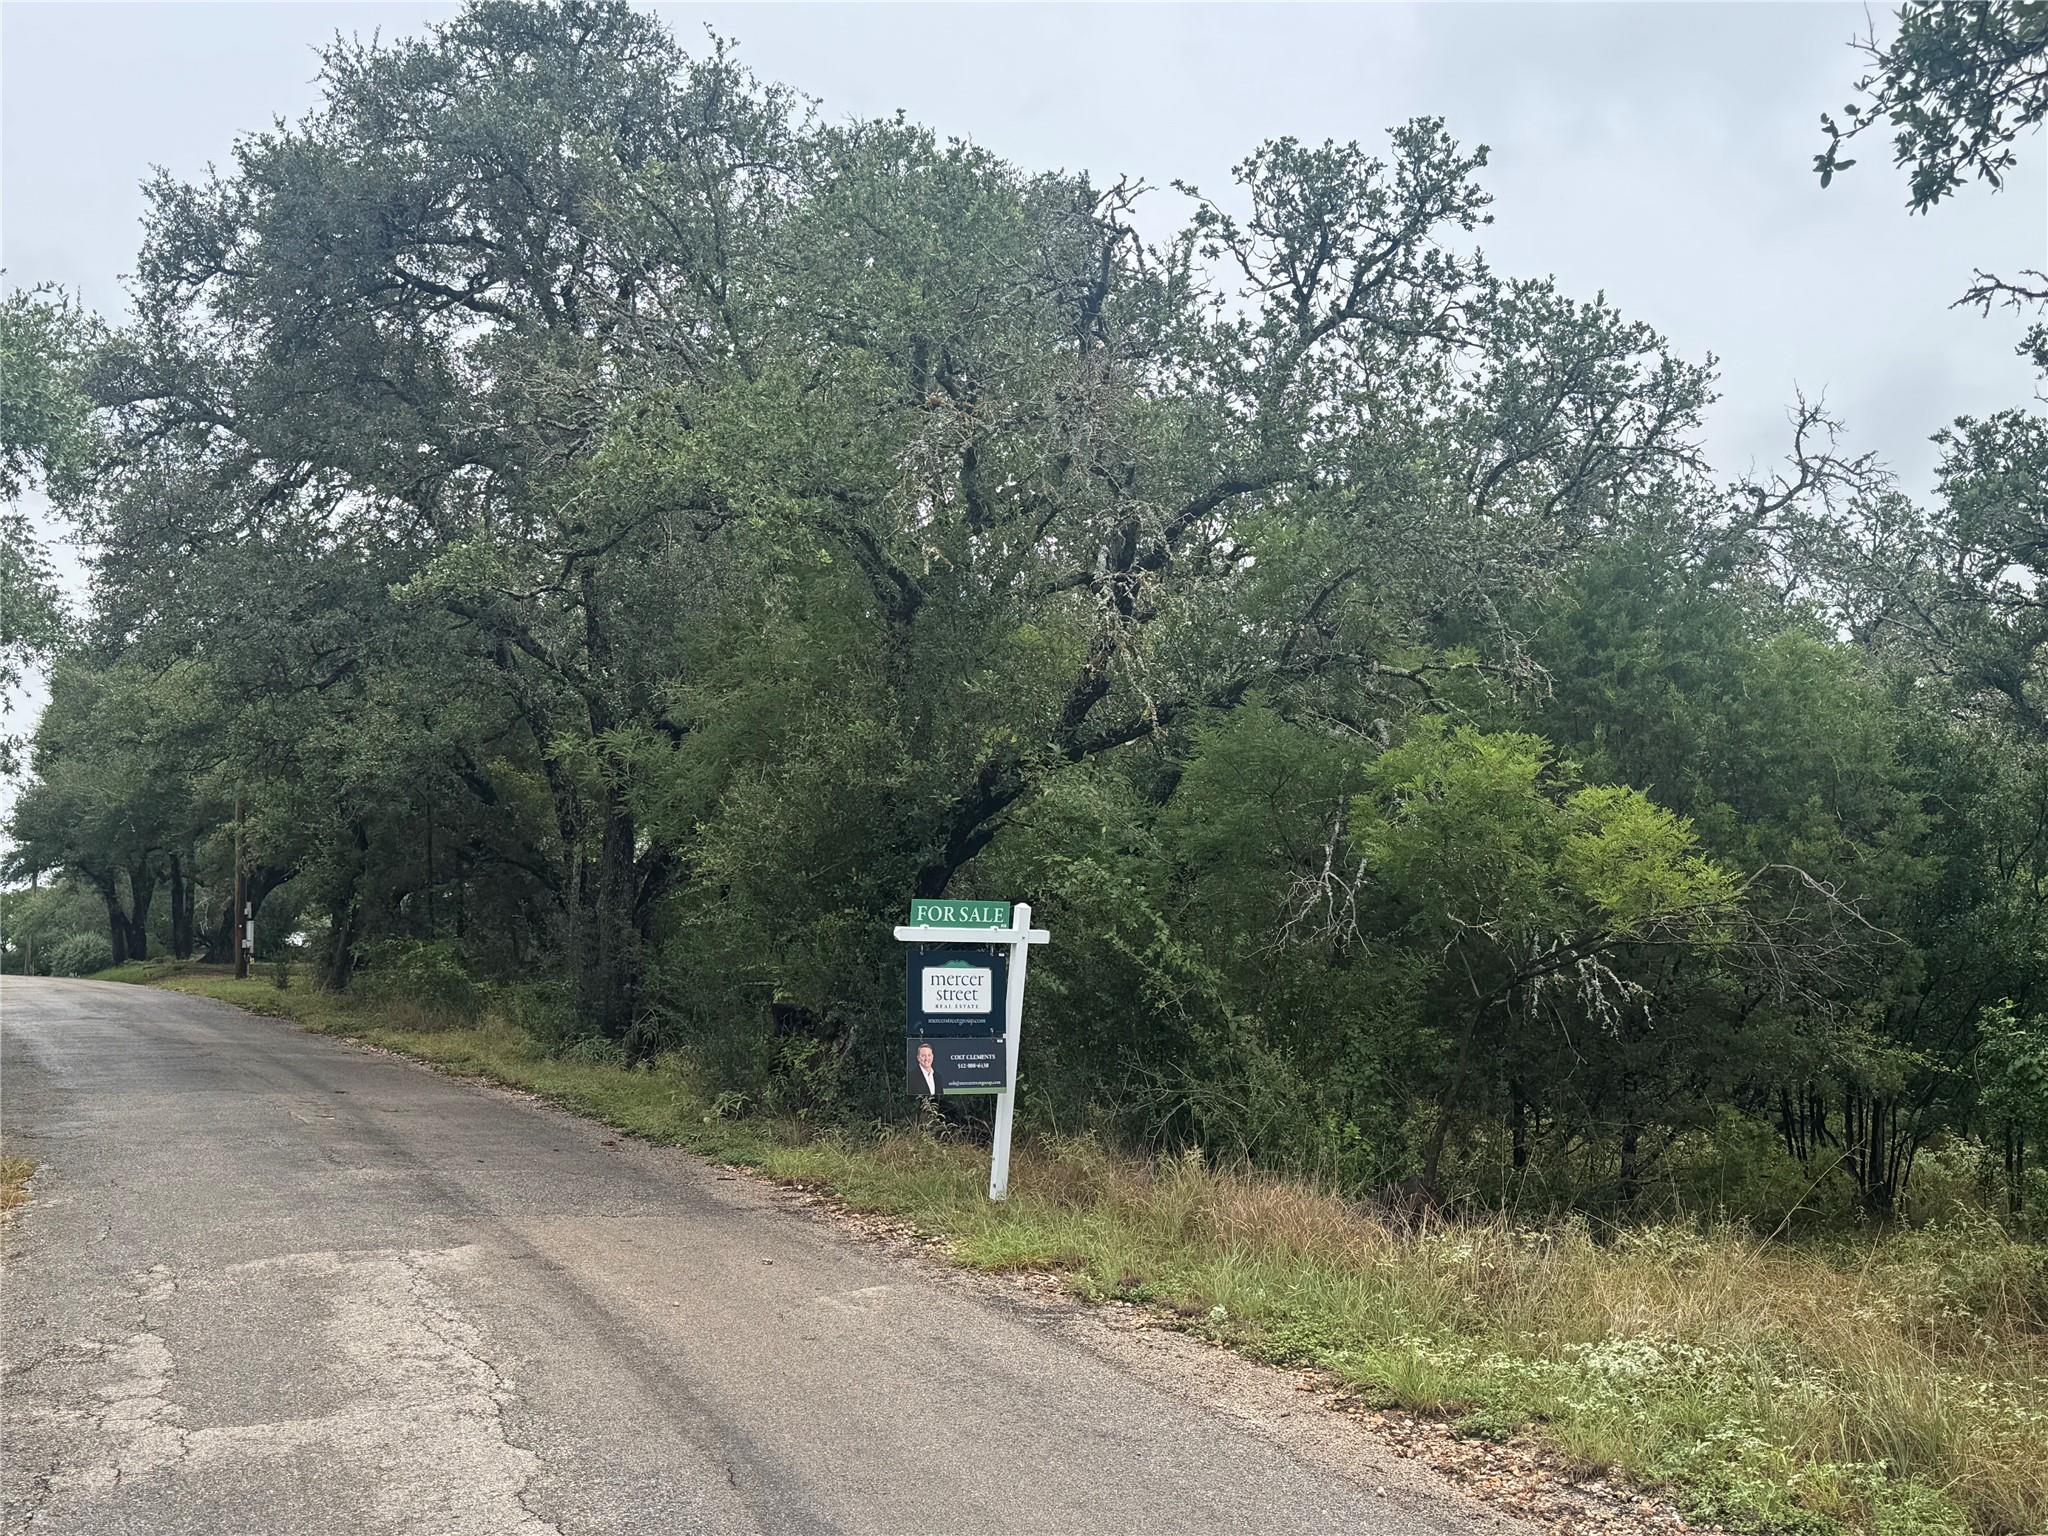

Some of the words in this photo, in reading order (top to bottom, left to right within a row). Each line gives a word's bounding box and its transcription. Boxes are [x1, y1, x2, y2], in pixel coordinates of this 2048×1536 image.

[917, 906, 956, 922] FOR
[959, 906, 1004, 923] SALE
[930, 974, 984, 987] mercer
[936, 988, 978, 1001] street
